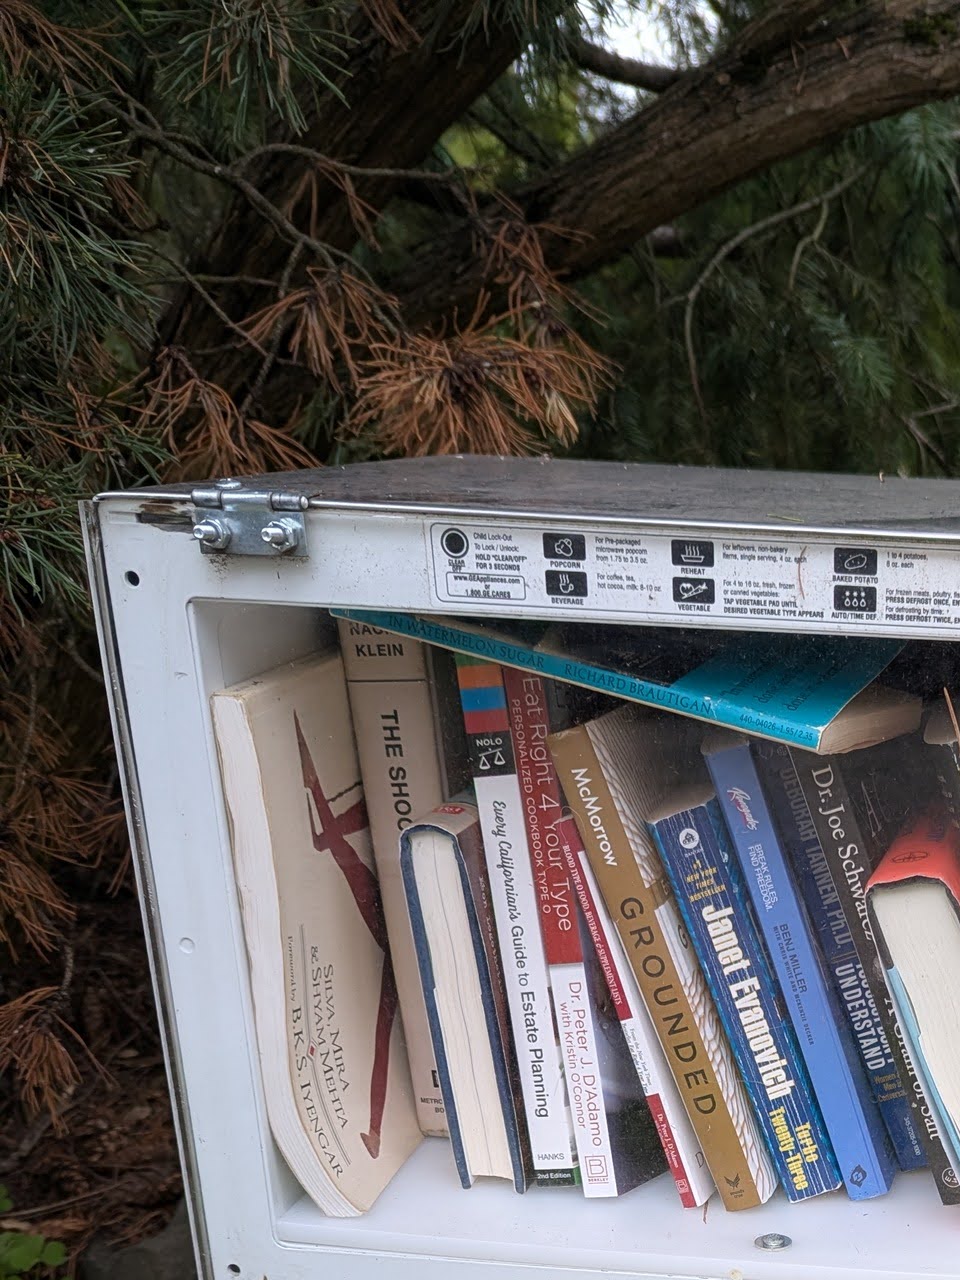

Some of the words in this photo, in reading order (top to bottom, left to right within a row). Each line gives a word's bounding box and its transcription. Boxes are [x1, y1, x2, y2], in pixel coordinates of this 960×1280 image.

[854, 576, 878, 584] POTATO
[678, 604, 711, 612] VEGETABLE
[831, 612, 864, 620] AUTO/TIME
[355, 643, 404, 658] KLEIN
[388, 615, 404, 630] IN
[407, 619, 498, 655] WATERMELON
[499, 646, 545, 669] SUGAR
[522, 677, 542, 717] Eat
[563, 663, 627, 693] RICHARD
[628, 682, 713, 716] BRAUTIGAN
[381, 709, 404, 758] THE
[476, 737, 503, 748] NOLO
[512, 698, 532, 794] PERSONALIZED
[529, 723, 554, 786] Right
[538, 793, 560, 812] 4
[812, 764, 834, 804] Dr.
[492, 800, 507, 839] Every
[526, 797, 544, 868] COOKBOOK
[571, 768, 618, 867] McMorrow
[818, 804, 845, 840] Joe
[686, 873, 700, 884] NEW
[700, 868, 718, 879] YORK
[748, 846, 760, 867] FIND
[754, 868, 773, 912] FREEDOM.
[754, 844, 770, 874] BREAK
[496, 840, 520, 923] Californian's
[537, 870, 550, 900] TYPE
[688, 884, 727, 902] BESTSELLER
[695, 879, 714, 890] TIMES
[543, 904, 552, 914] O
[550, 877, 572, 932] Type
[510, 924, 528, 968] Guide
[778, 923, 794, 953] BENJ
[788, 954, 808, 994] MILLER
[518, 971, 530, 987] to
[568, 982, 582, 1004] Dr.
[520, 991, 538, 1043] Estate
[560, 1002, 572, 1028] with
[620, 896, 717, 1116] GROUNDED
[702, 904, 751, 976] Janet
[730, 976, 796, 1101] Evanovich
[834, 964, 886, 1072] UNDERSTAND
[312, 966, 327, 1046] SHYAM
[320, 1051, 348, 1129] MEHTA
[324, 964, 335, 1027] SILVA,
[330, 1028, 350, 1092] MIRA
[572, 1008, 589, 1052] Peter
[564, 1031, 576, 1070] Kristin
[580, 1056, 594, 1070] J.
[292, 1006, 308, 1078] B.K.S.
[300, 1082, 344, 1178] IYENGAR
[529, 1048, 549, 1118] Planning
[571, 1072, 586, 1129] O'Connor
[582, 1074, 602, 1147] D'Adamo
[537, 1152, 565, 1162] HANKS
[769, 1106, 810, 1192] Twenty-Three
[795, 1122, 820, 1164] Turbo
[537, 1172, 550, 1180] 2nd
[550, 1172, 572, 1180] Edition
